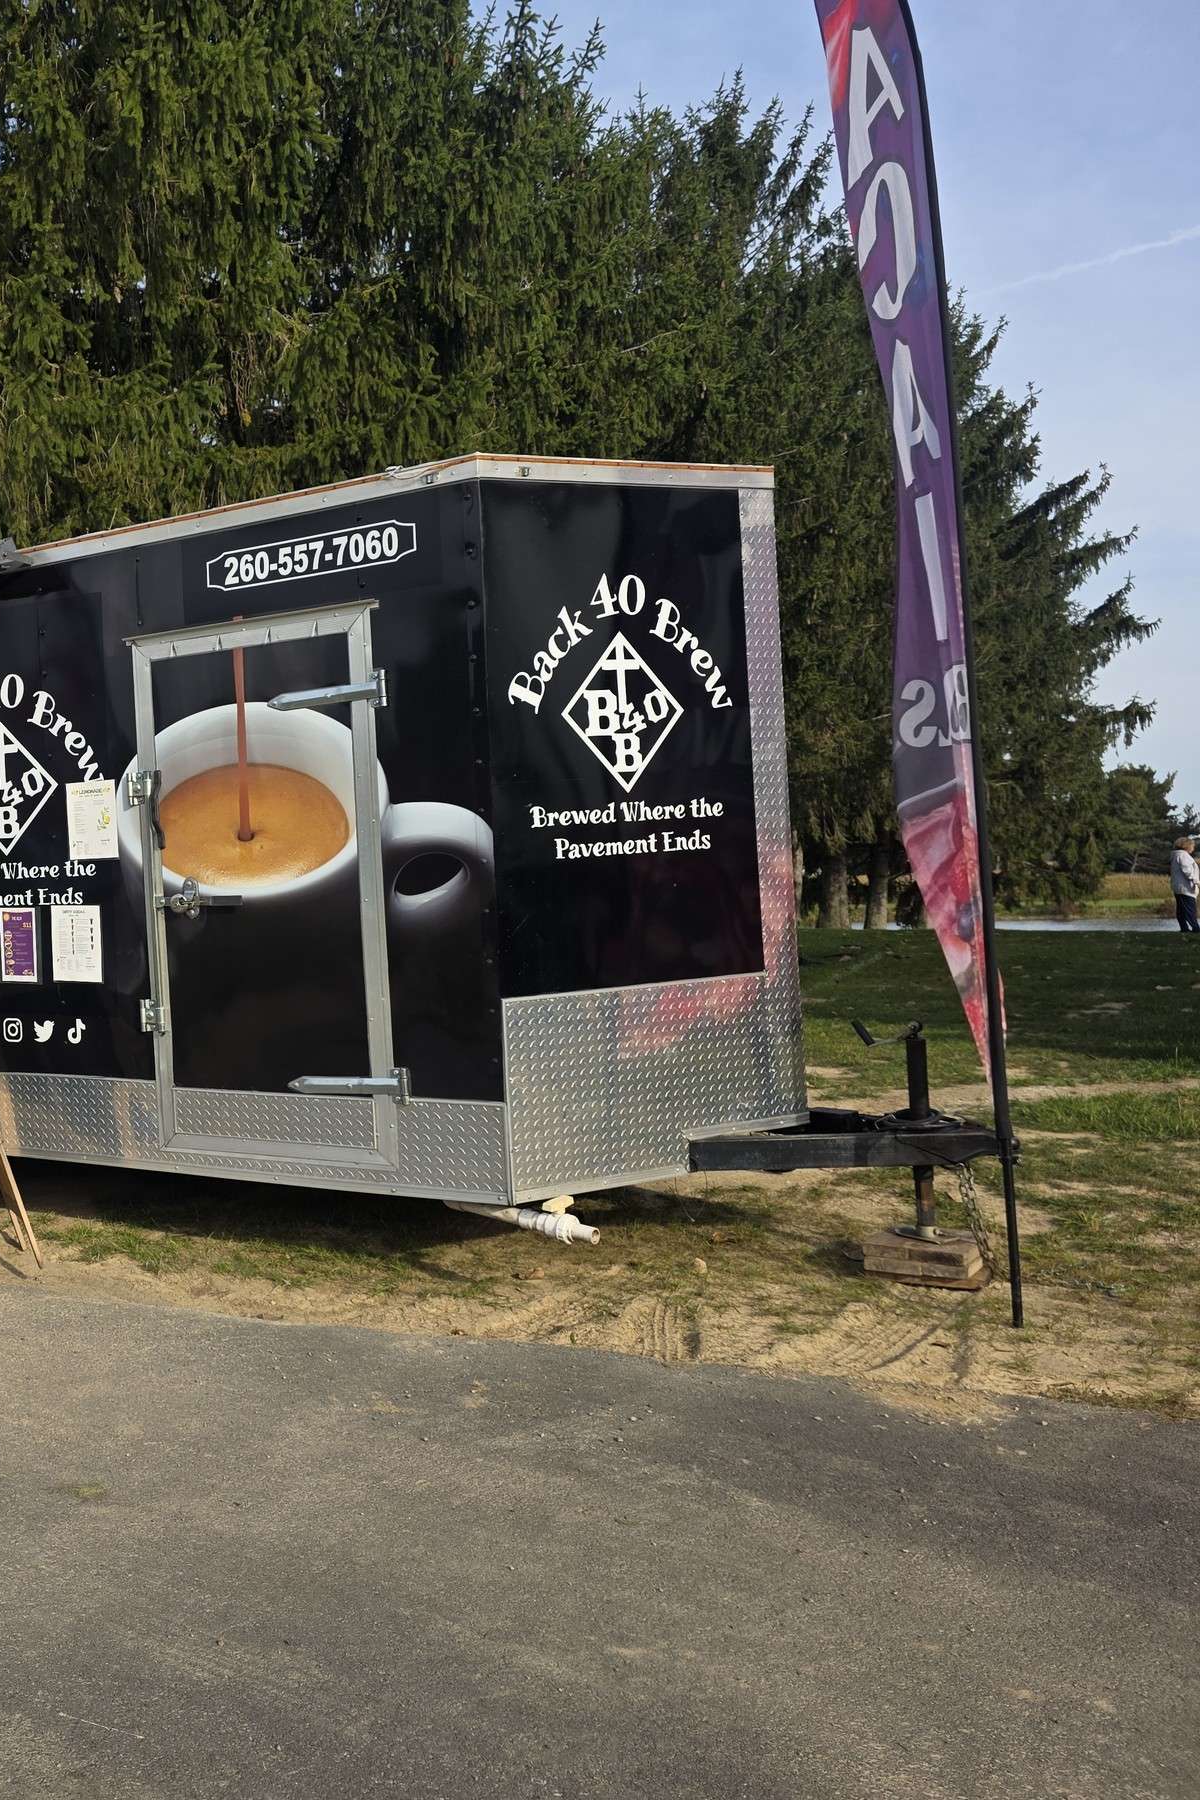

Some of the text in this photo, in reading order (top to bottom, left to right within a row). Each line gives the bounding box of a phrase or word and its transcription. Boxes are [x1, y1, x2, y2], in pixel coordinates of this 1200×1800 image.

[224, 527, 399, 586] 260-557-7060
[508, 573, 732, 714] Back 40 Brew
[27, 690, 104, 782] Brew
[530, 797, 724, 828] Brewed Where the
[554, 829, 711, 860] Pavement Ends
[1, 862, 60, 880] Where
[64, 860, 96, 878] the
[38, 887, 83, 906] Ends
